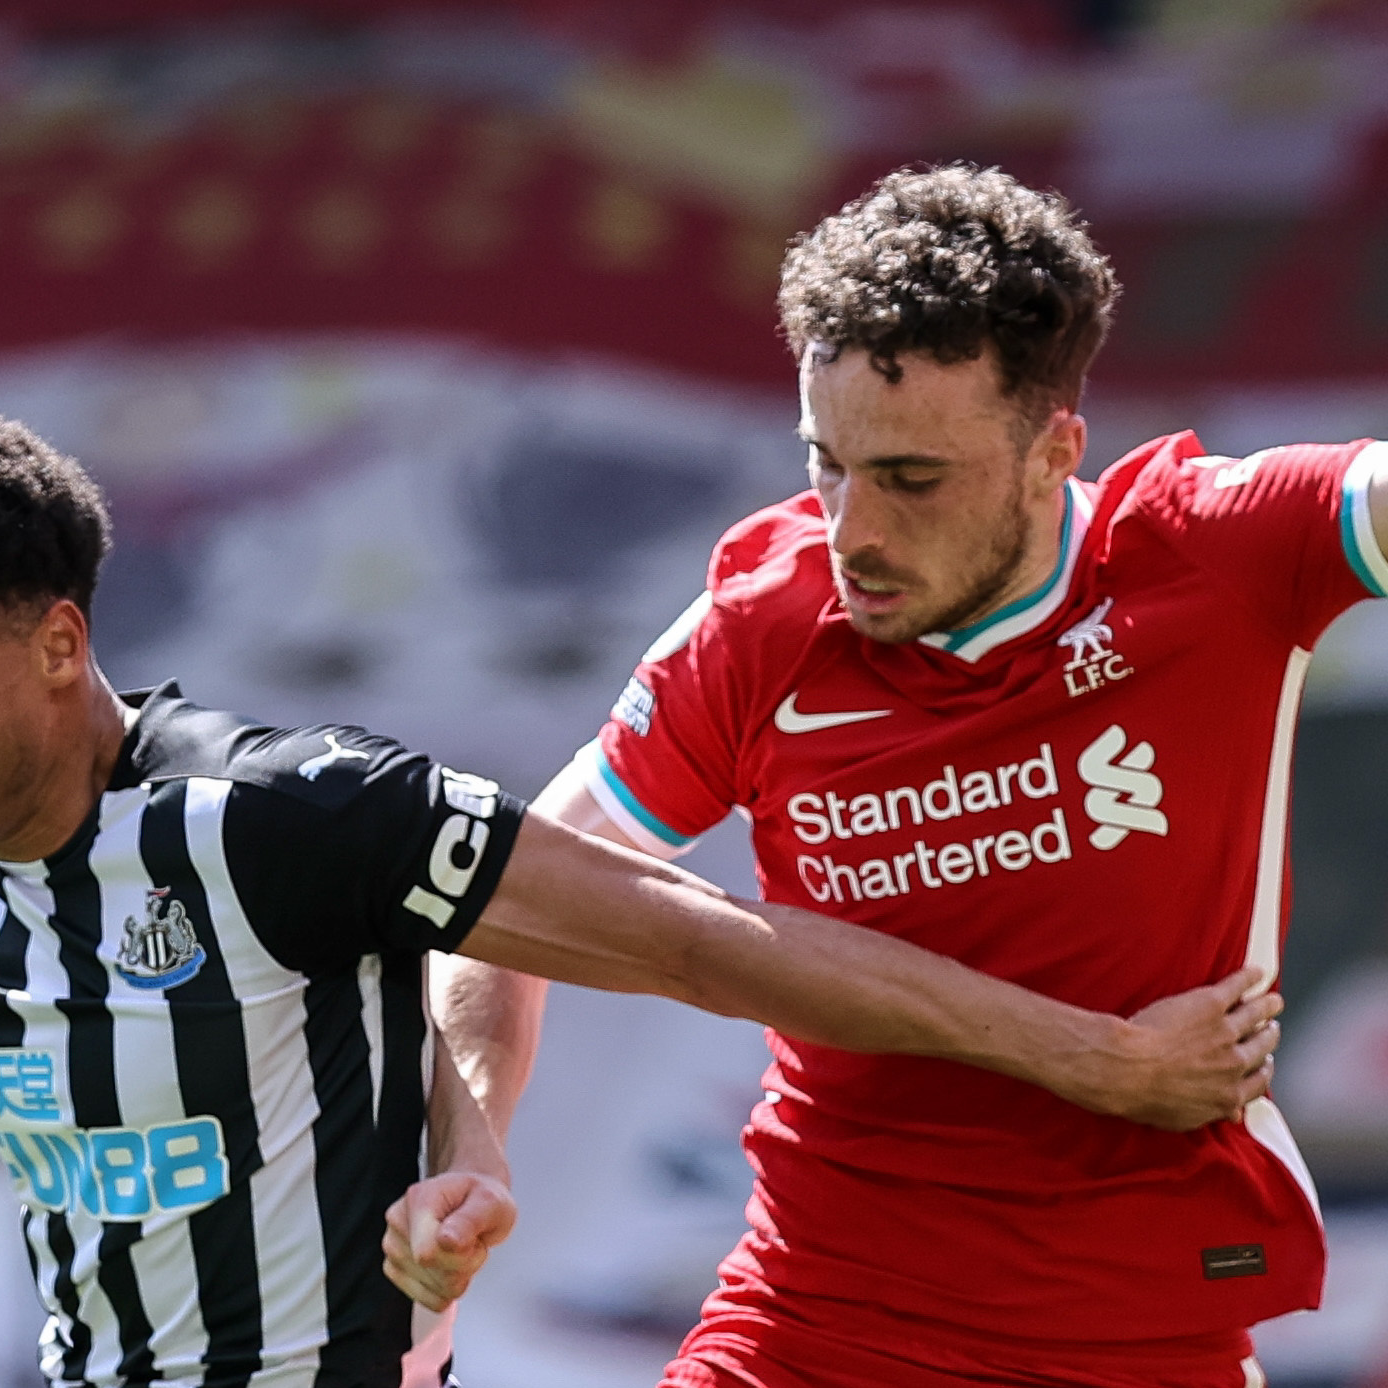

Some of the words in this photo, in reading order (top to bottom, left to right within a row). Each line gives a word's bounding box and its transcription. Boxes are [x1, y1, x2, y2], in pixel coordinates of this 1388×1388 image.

[1063, 654, 1135, 698] L.F.C.
[787, 743, 1059, 844] Standard
[797, 808, 1072, 904] Chartered
